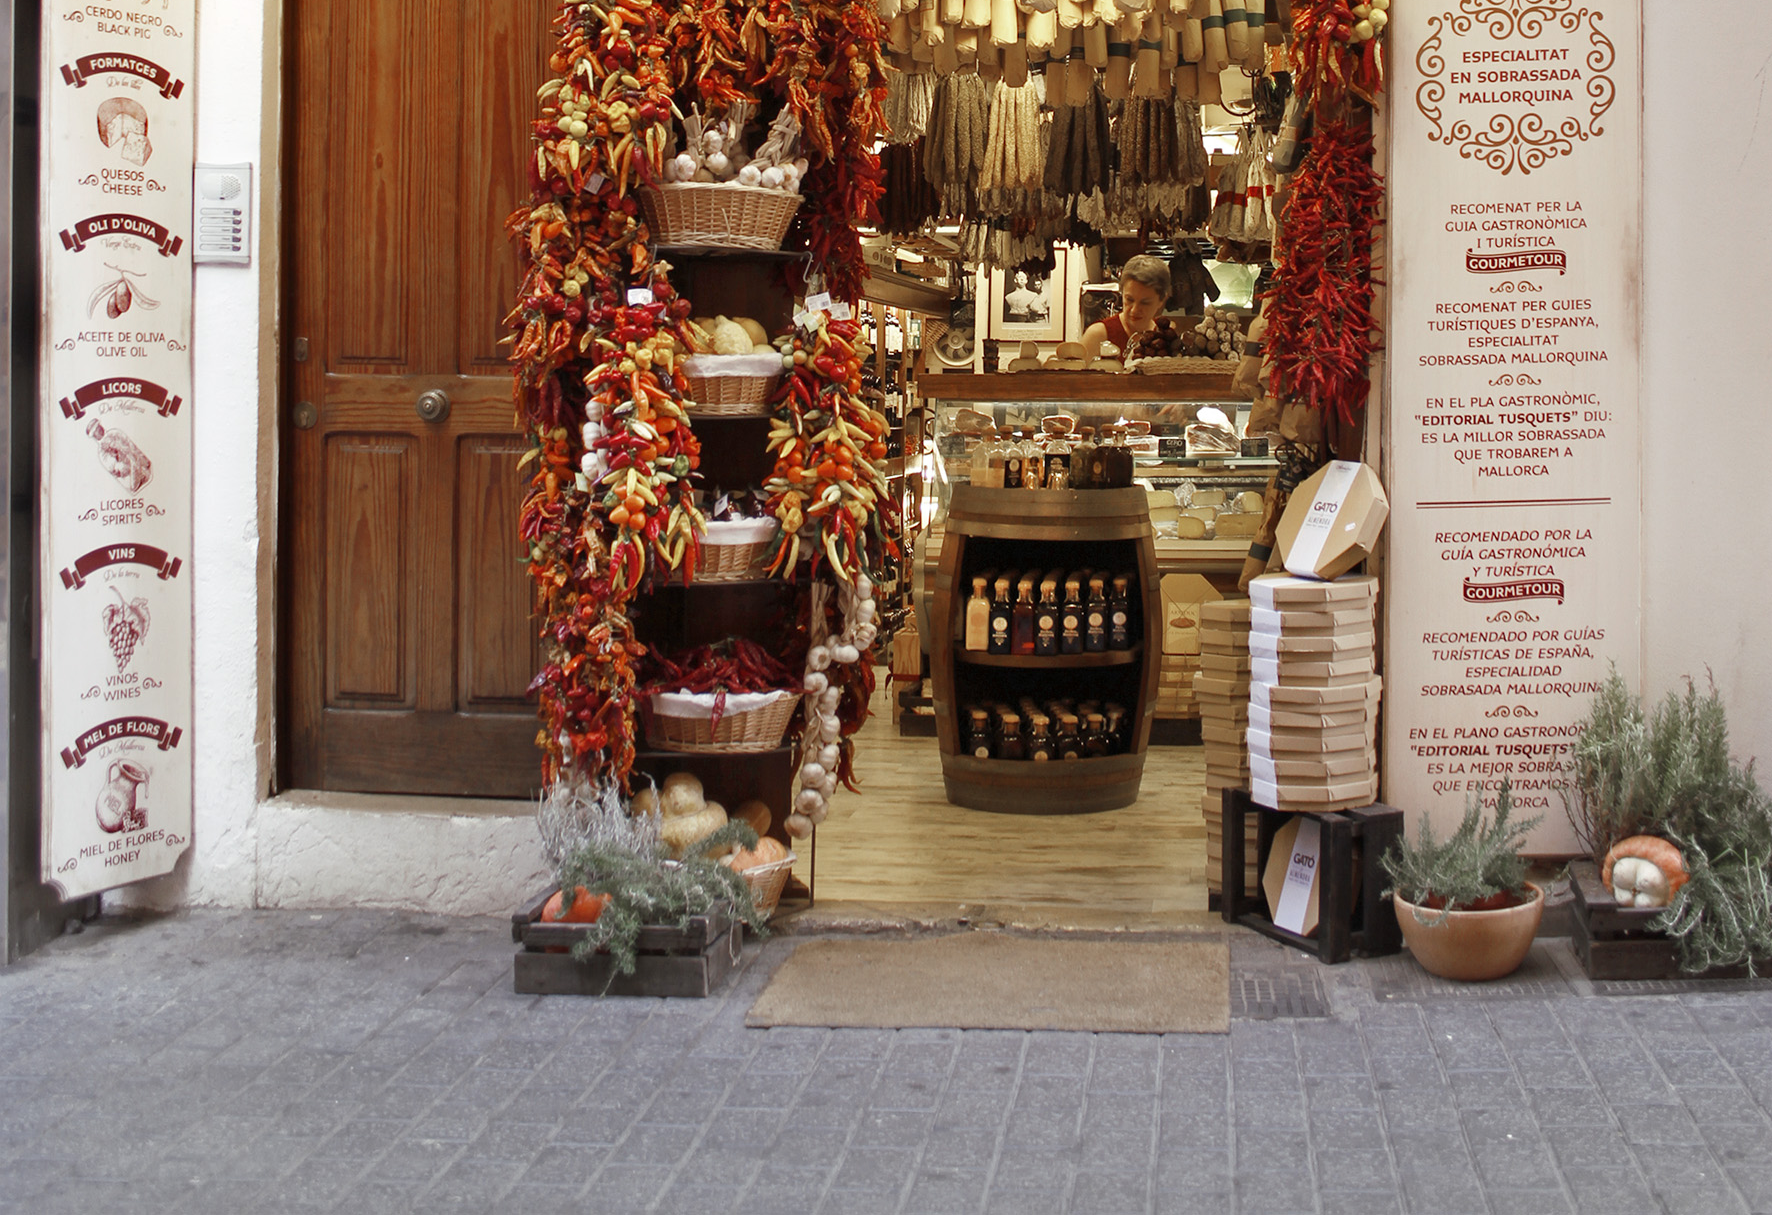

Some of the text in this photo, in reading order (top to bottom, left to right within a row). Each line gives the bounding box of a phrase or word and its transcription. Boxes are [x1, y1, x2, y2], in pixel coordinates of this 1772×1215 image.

[86, 5, 162, 27] CERDO NEGRO
[97, 21, 151, 39] BLACK PIG
[1463, 49, 1569, 63] ESPECIALITAT
[90, 58, 157, 79] FORMATGES
[1451, 69, 1581, 83] EN SOBRASSADA
[1459, 90, 1573, 106] MALLORQUINA
[101, 168, 144, 181] QUESOS
[102, 183, 143, 196] CHEESE
[1451, 201, 1582, 214] RECOMENAT PER LA
[89, 220, 109, 232] OLI
[1445, 215, 1587, 232] GUIA GASTRONÒMICA
[1477, 234, 1555, 248] I TURÍSTICA
[1469, 254, 1563, 270] GOURMETOUR
[1436, 299, 1591, 313] RECOMENAT PER GUIES
[1428, 318, 1518, 334] TURÍSTIQUES
[78, 332, 166, 343] ACEITE DE OLIVA
[1468, 335, 1559, 348] ESPECIALITAT
[96, 347, 147, 357] OLIVE OIL
[1419, 351, 1608, 366] SOBRASSADA MALLORQUINA
[102, 383, 142, 396] LICORS
[1427, 392, 1600, 408] EN EL PLA GASTRONÒMIC,
[1584, 411, 1611, 421] DIU:
[1422, 428, 1606, 443] ES LA MILLOR SOBRASSADA
[1454, 447, 1573, 464] QUE TROBAREM A
[1479, 465, 1549, 476] MALLORCA
[101, 498, 144, 511] LICORES
[1314, 501, 1338, 513] GATÓ
[102, 513, 142, 526] SPIRITS
[1435, 529, 1592, 543] RECOMENDADO POR LA
[108, 548, 136, 561] VINS
[1441, 545, 1585, 560] GUÍA GASTRONÓMICA
[1473, 562, 1554, 576] Y TURÍSTICA
[1466, 584, 1561, 599] GOURMETOUR
[1423, 627, 1604, 643] RECOMENDADO POR GUÍAS
[1433, 644, 1593, 660] TURÍSTICAS DE ESPAÑA,
[1466, 666, 1561, 677] ESPECIALIDAD
[106, 672, 139, 687] VINOS
[103, 687, 141, 702] WINES
[1421, 685, 1502, 696] SOBRASADA
[83, 722, 161, 749] MEL DE FLORS
[1410, 729, 1427, 739] EN
[1433, 728, 1448, 738] EL
[1454, 727, 1499, 738] PLANO
[1428, 763, 1444, 774] ES
[1449, 763, 1465, 773] LA
[1470, 762, 1513, 777] MEJOR
[1433, 781, 1461, 795] QUE
[1480, 797, 1549, 808] MAORCA
[79, 830, 165, 859] MIEL DE FLORES
[104, 850, 140, 867] HONEY
[1294, 853, 1315, 868] GATÓ
